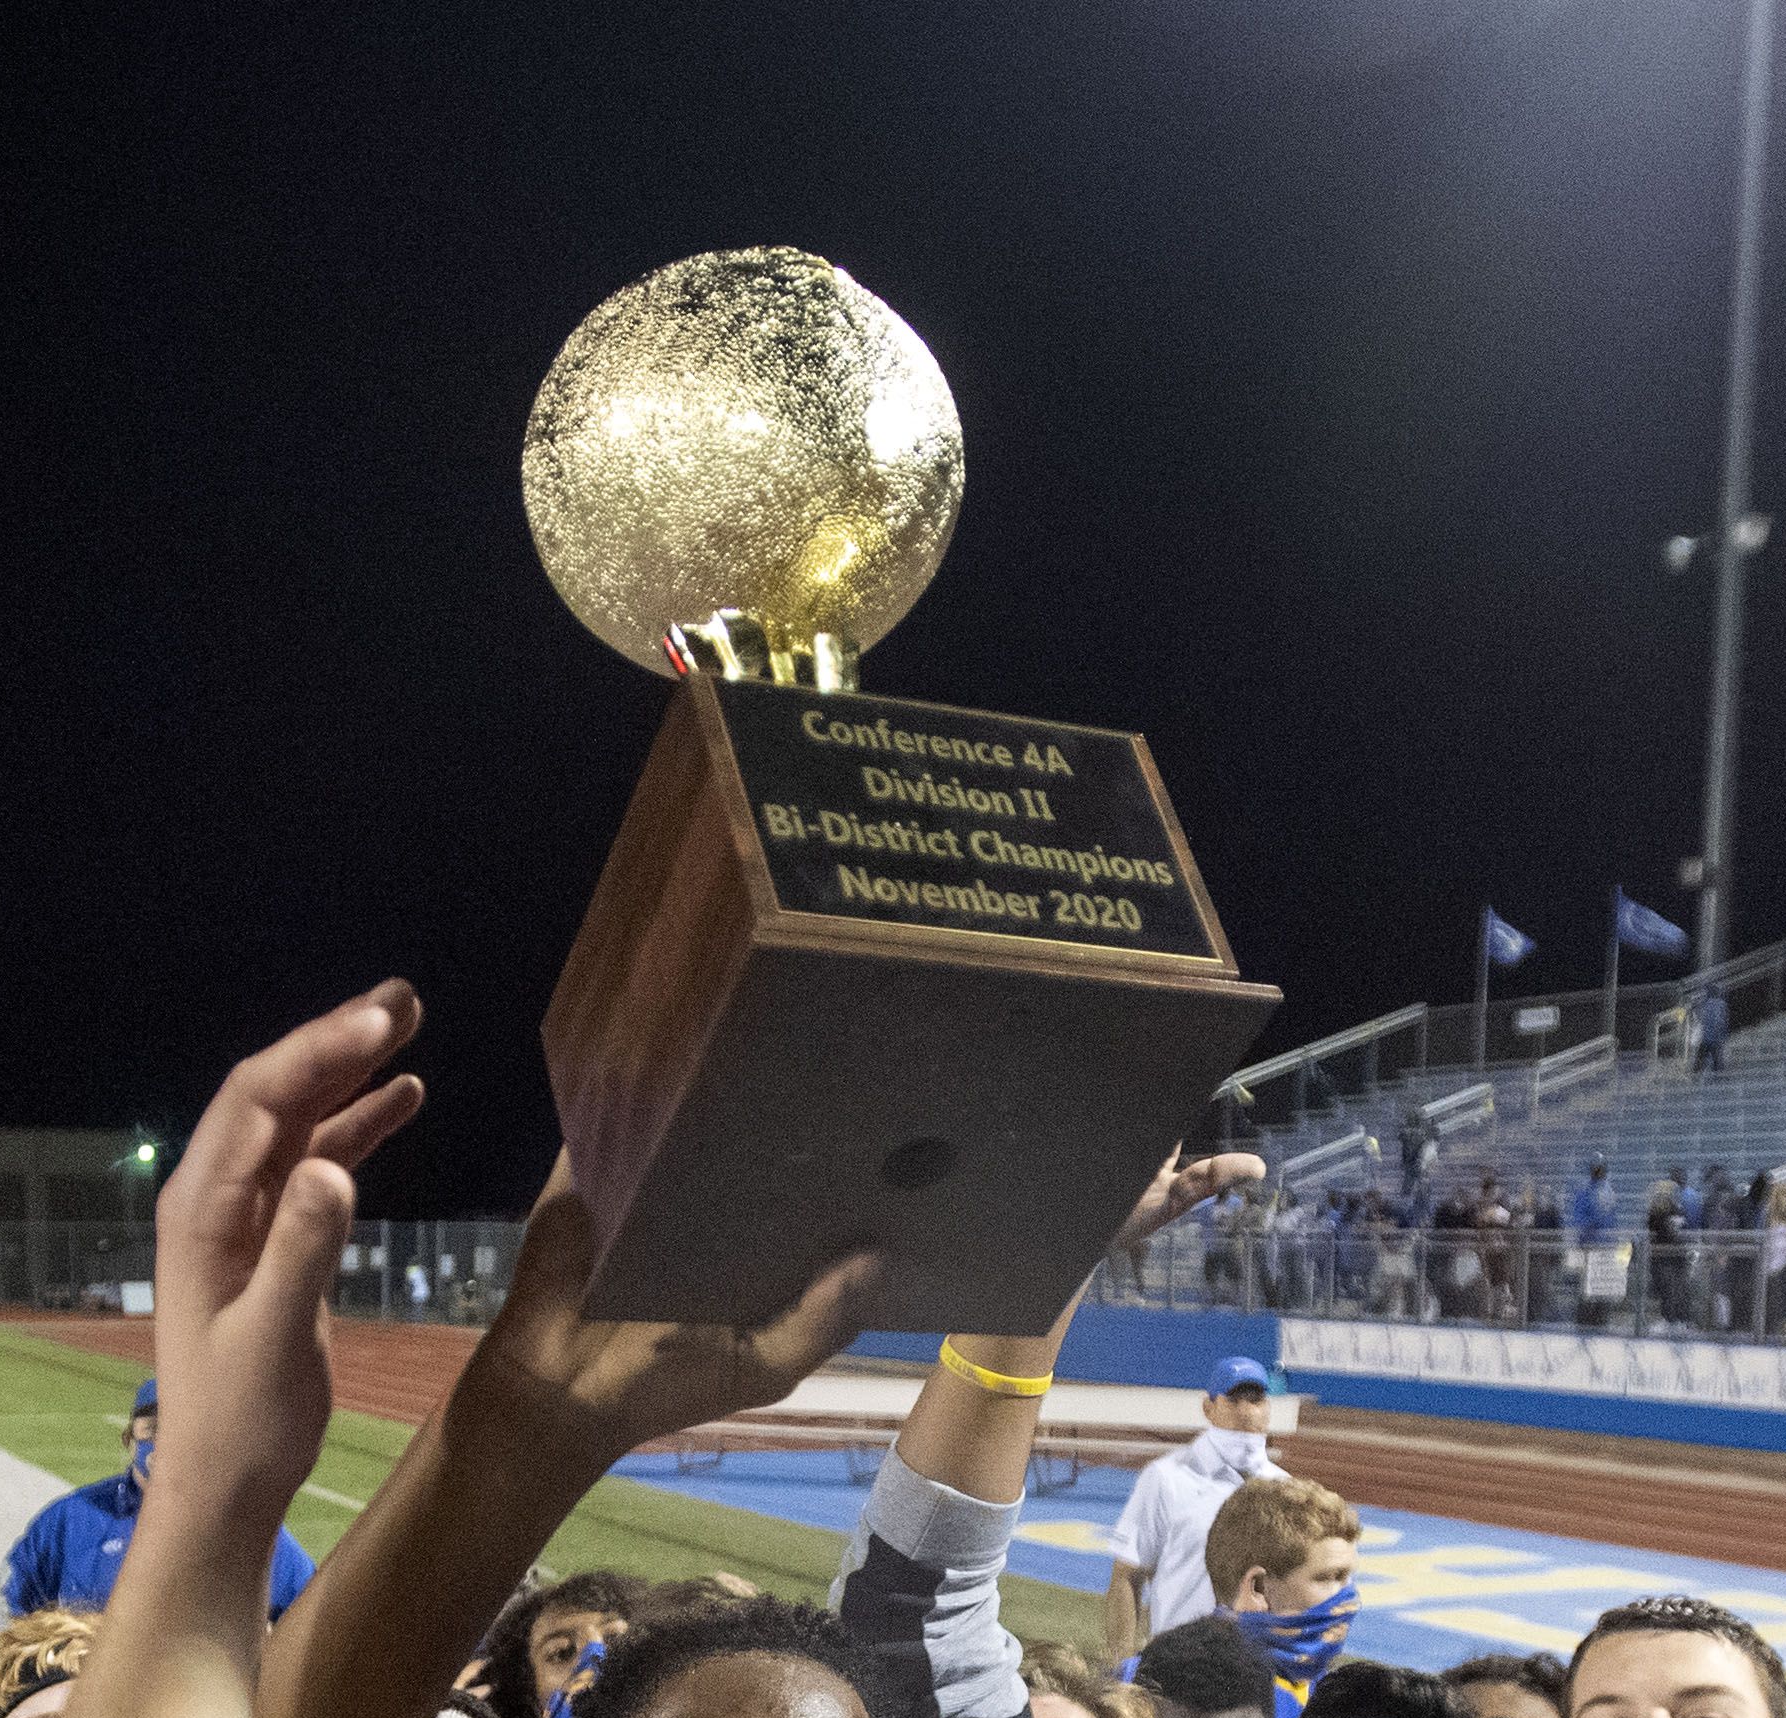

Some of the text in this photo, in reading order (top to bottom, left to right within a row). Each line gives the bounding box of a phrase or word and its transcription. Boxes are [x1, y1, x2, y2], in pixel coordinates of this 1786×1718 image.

[801, 710, 1072, 777] Conference 4A
[864, 767, 1055, 822] Division II
[763, 803, 1175, 888] Bi-District Champions
[839, 866, 1142, 932] November 2020
